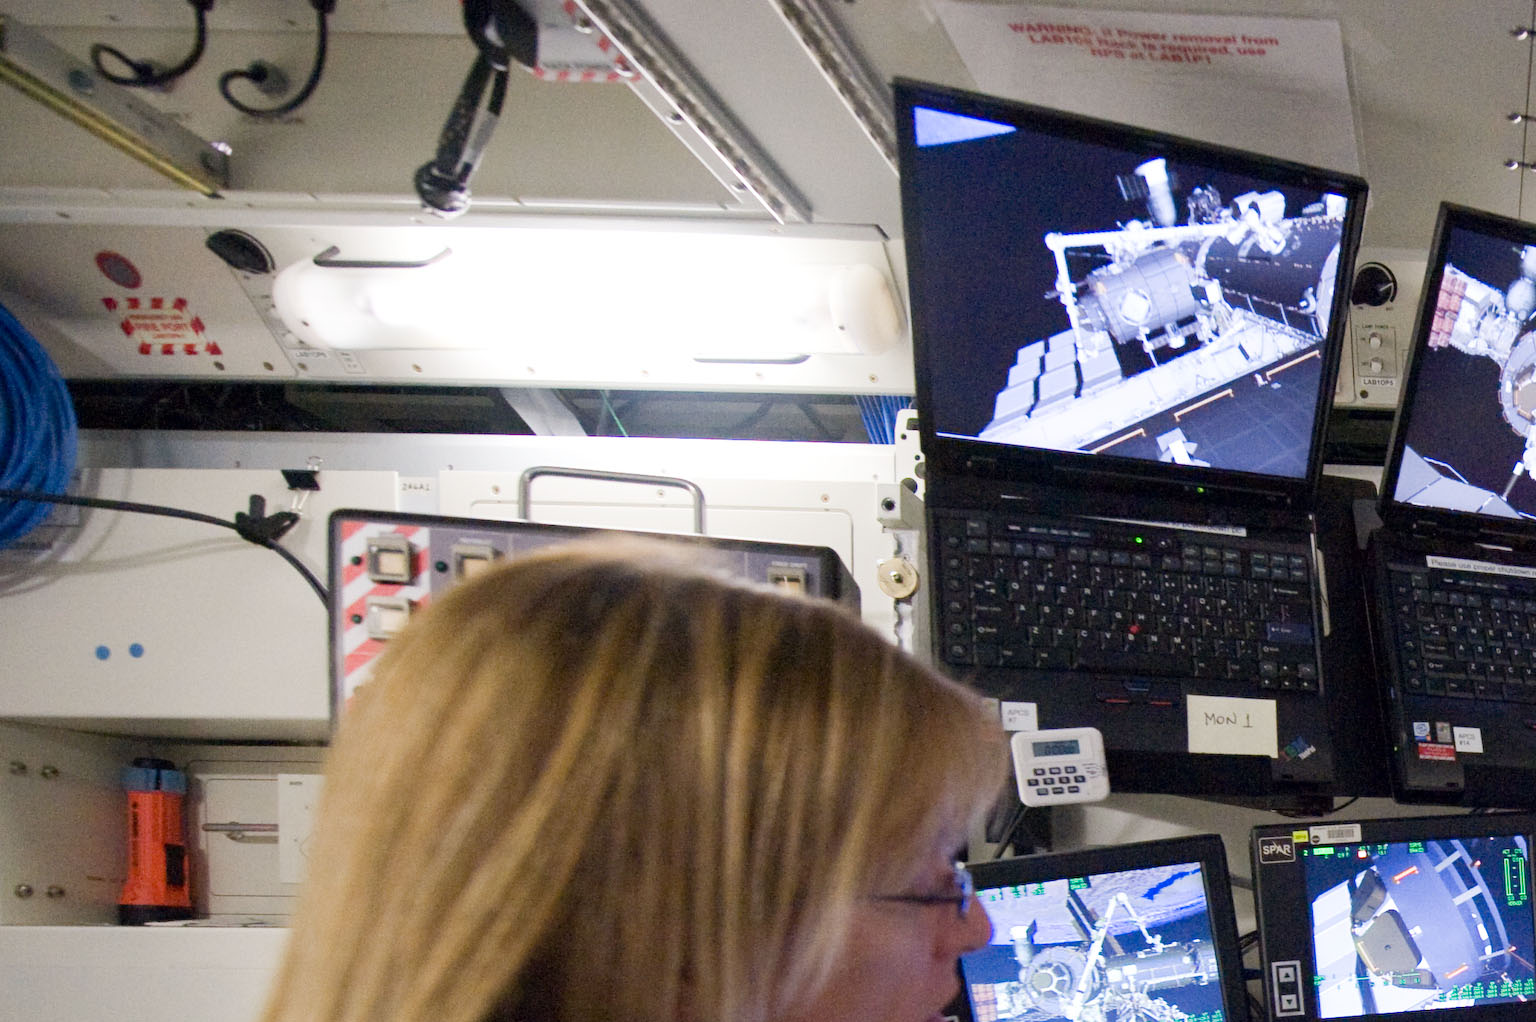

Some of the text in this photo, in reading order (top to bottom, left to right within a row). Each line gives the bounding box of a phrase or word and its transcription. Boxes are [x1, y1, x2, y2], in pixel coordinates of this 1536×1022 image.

[1172, 33, 1238, 45] removal
[1240, 35, 1280, 46] from
[1236, 48, 1267, 56] use
[1204, 712, 1237, 726] MON
[1262, 843, 1292, 857] SPAR
